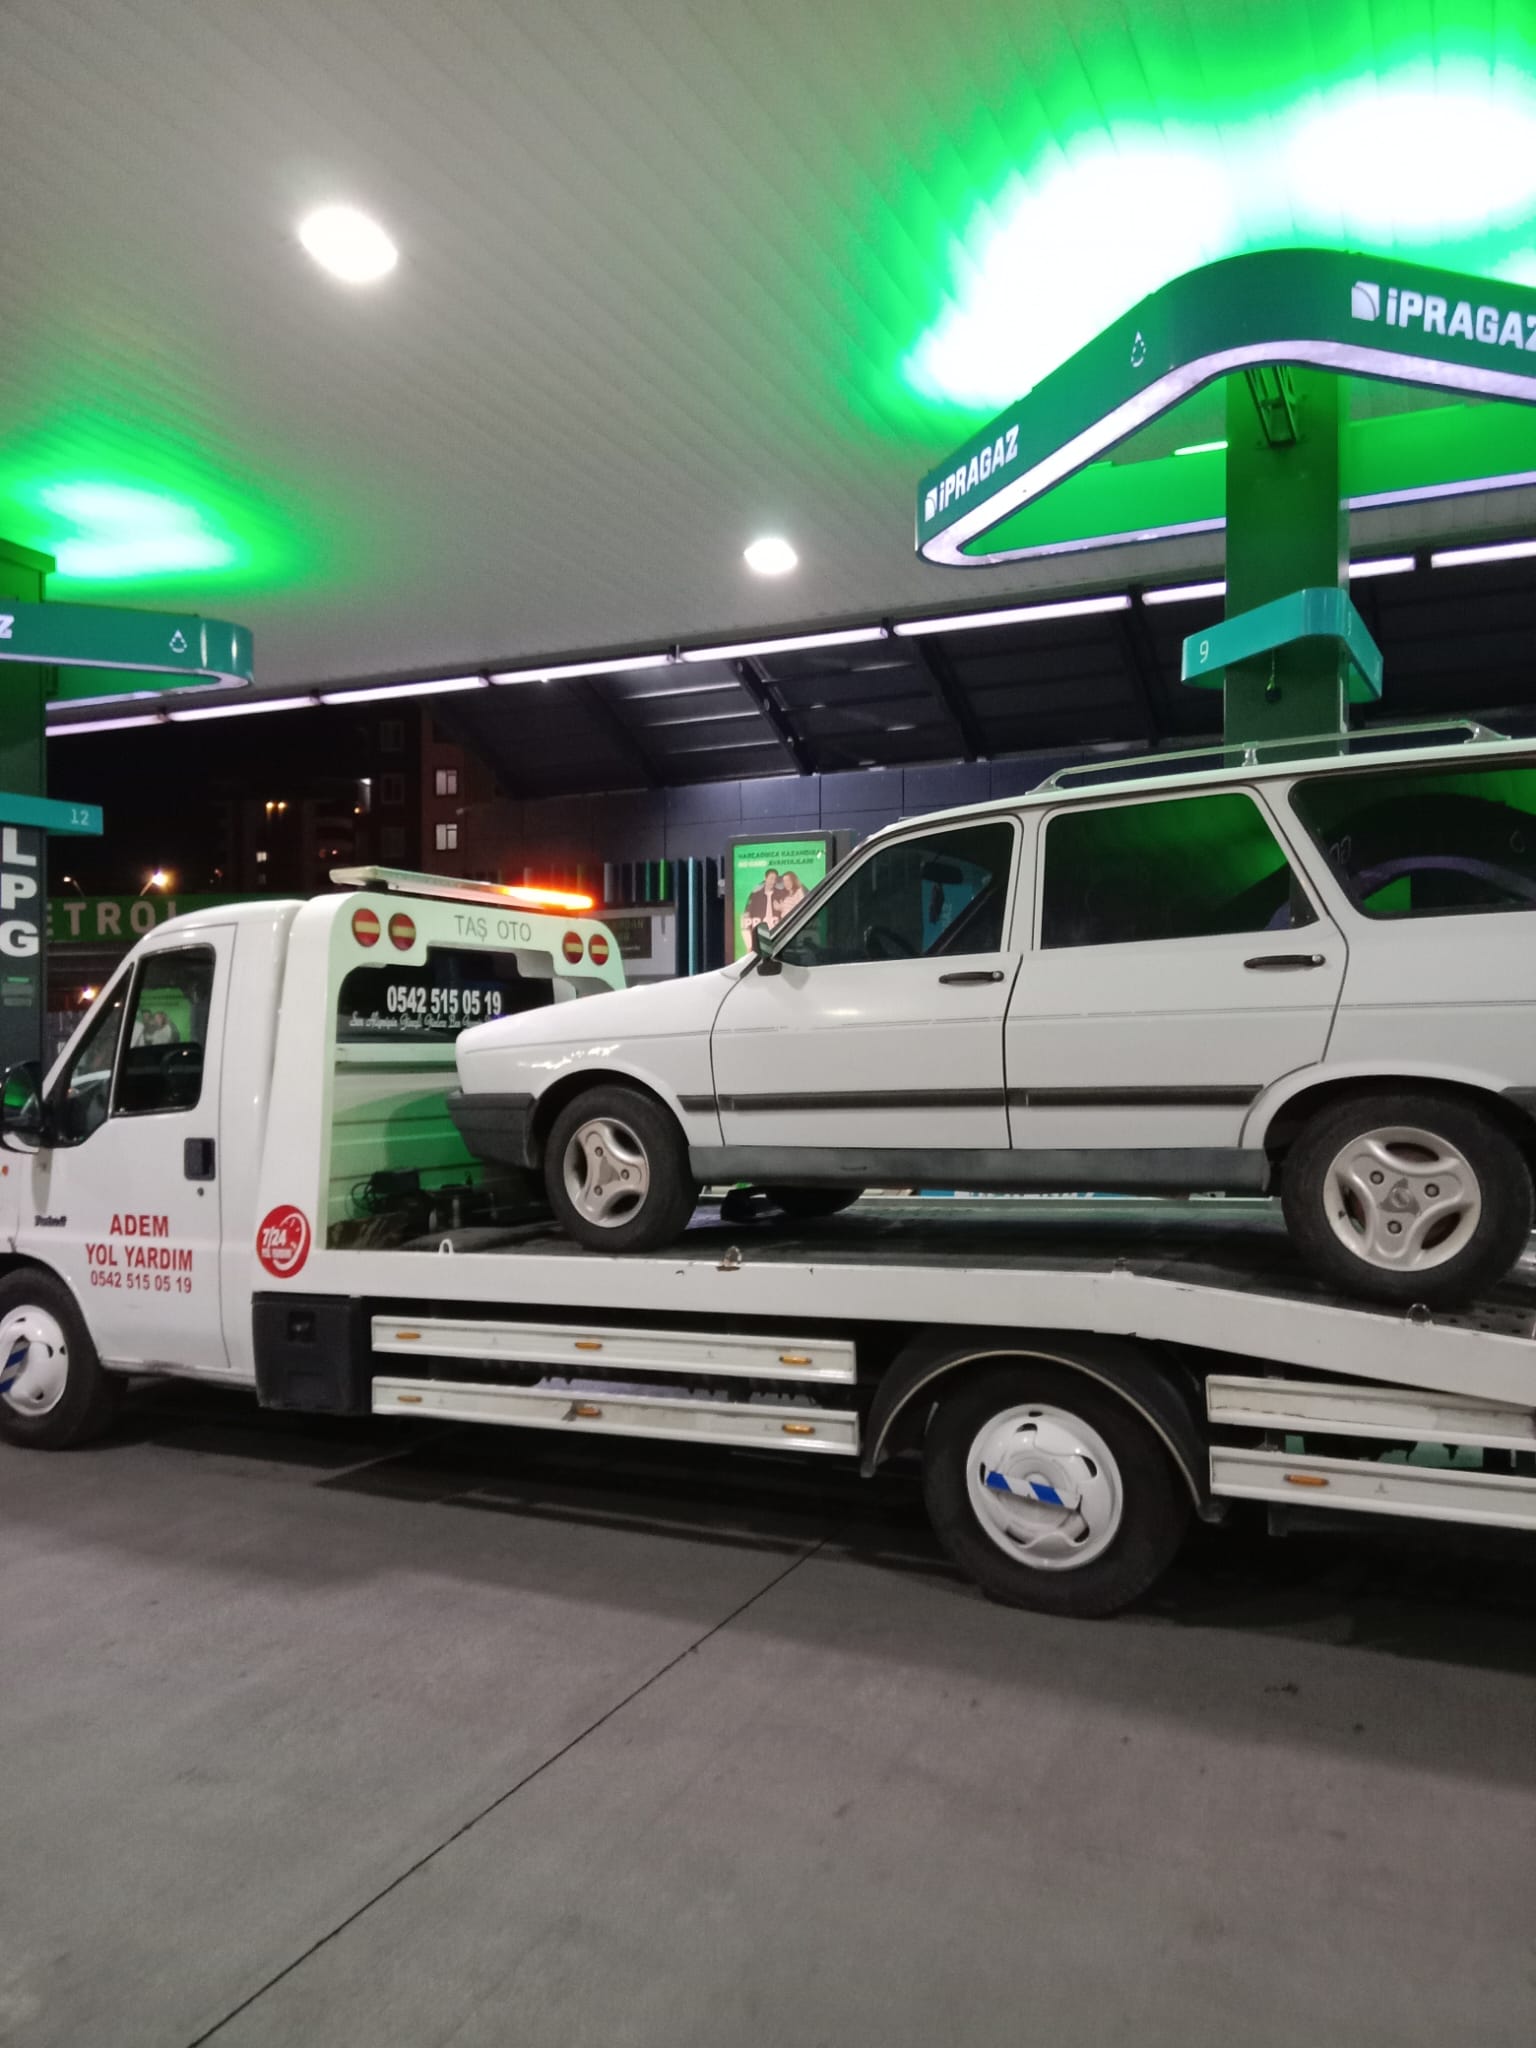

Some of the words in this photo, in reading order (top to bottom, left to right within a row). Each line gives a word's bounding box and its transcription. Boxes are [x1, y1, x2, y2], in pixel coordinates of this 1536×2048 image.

[1200, 640, 1209, 664] 9
[71, 808, 89, 826] 12
[46, 901, 177, 937] TRO
[454, 915, 488, 942] TAŞ
[497, 920, 531, 942] OTO
[387, 985, 427, 1013] 0542
[431, 988, 459, 1014] 515
[462, 990, 481, 1015] 05
[484, 991, 501, 1015] 19
[109, 1213, 169, 1238] ADEM
[85, 1243, 118, 1267] YOL
[124, 1245, 193, 1272] YARDIM
[90, 1270, 122, 1288] 0542
[126, 1272, 150, 1290] 515
[154, 1274, 171, 1292] 05
[176, 1276, 192, 1294] 19
